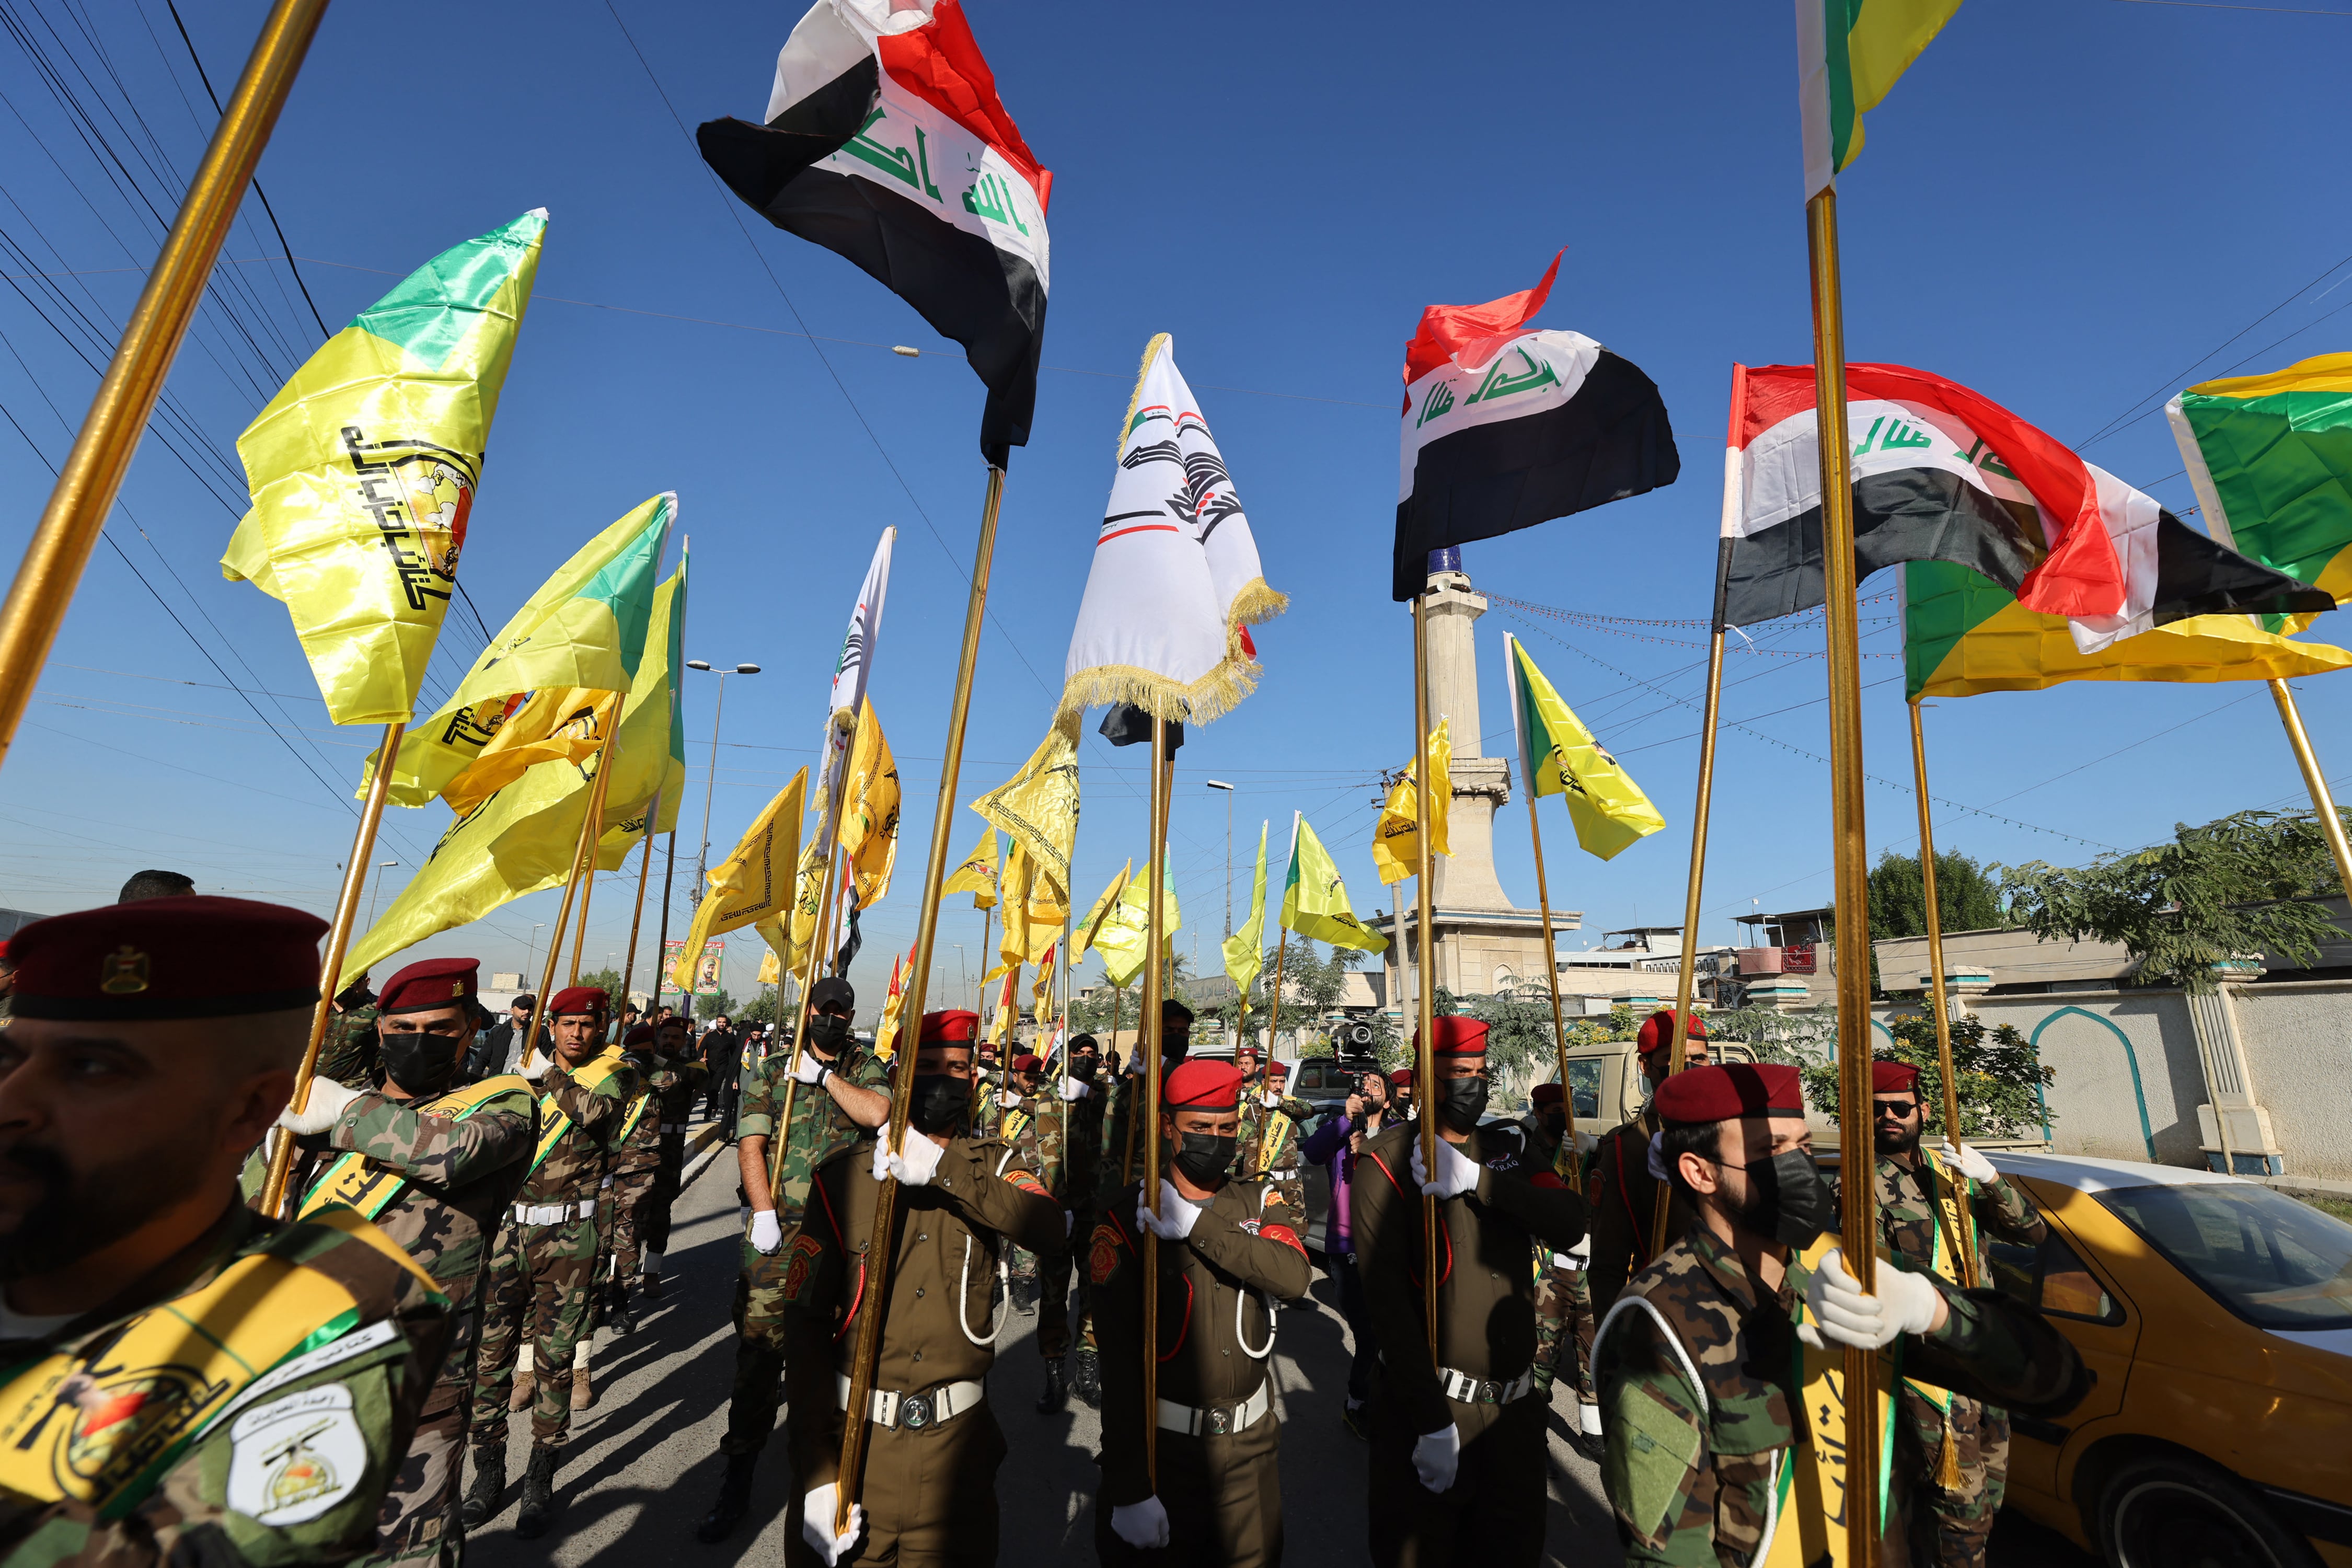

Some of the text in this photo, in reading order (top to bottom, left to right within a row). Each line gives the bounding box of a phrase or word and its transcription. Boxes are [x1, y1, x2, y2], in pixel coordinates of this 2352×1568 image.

[961, 152, 1030, 237] الله
[1269, 1122, 1283, 1148] كتائب
[324, 1157, 393, 1206] كتا
[1495, 1159, 1519, 1171] IRAQ
